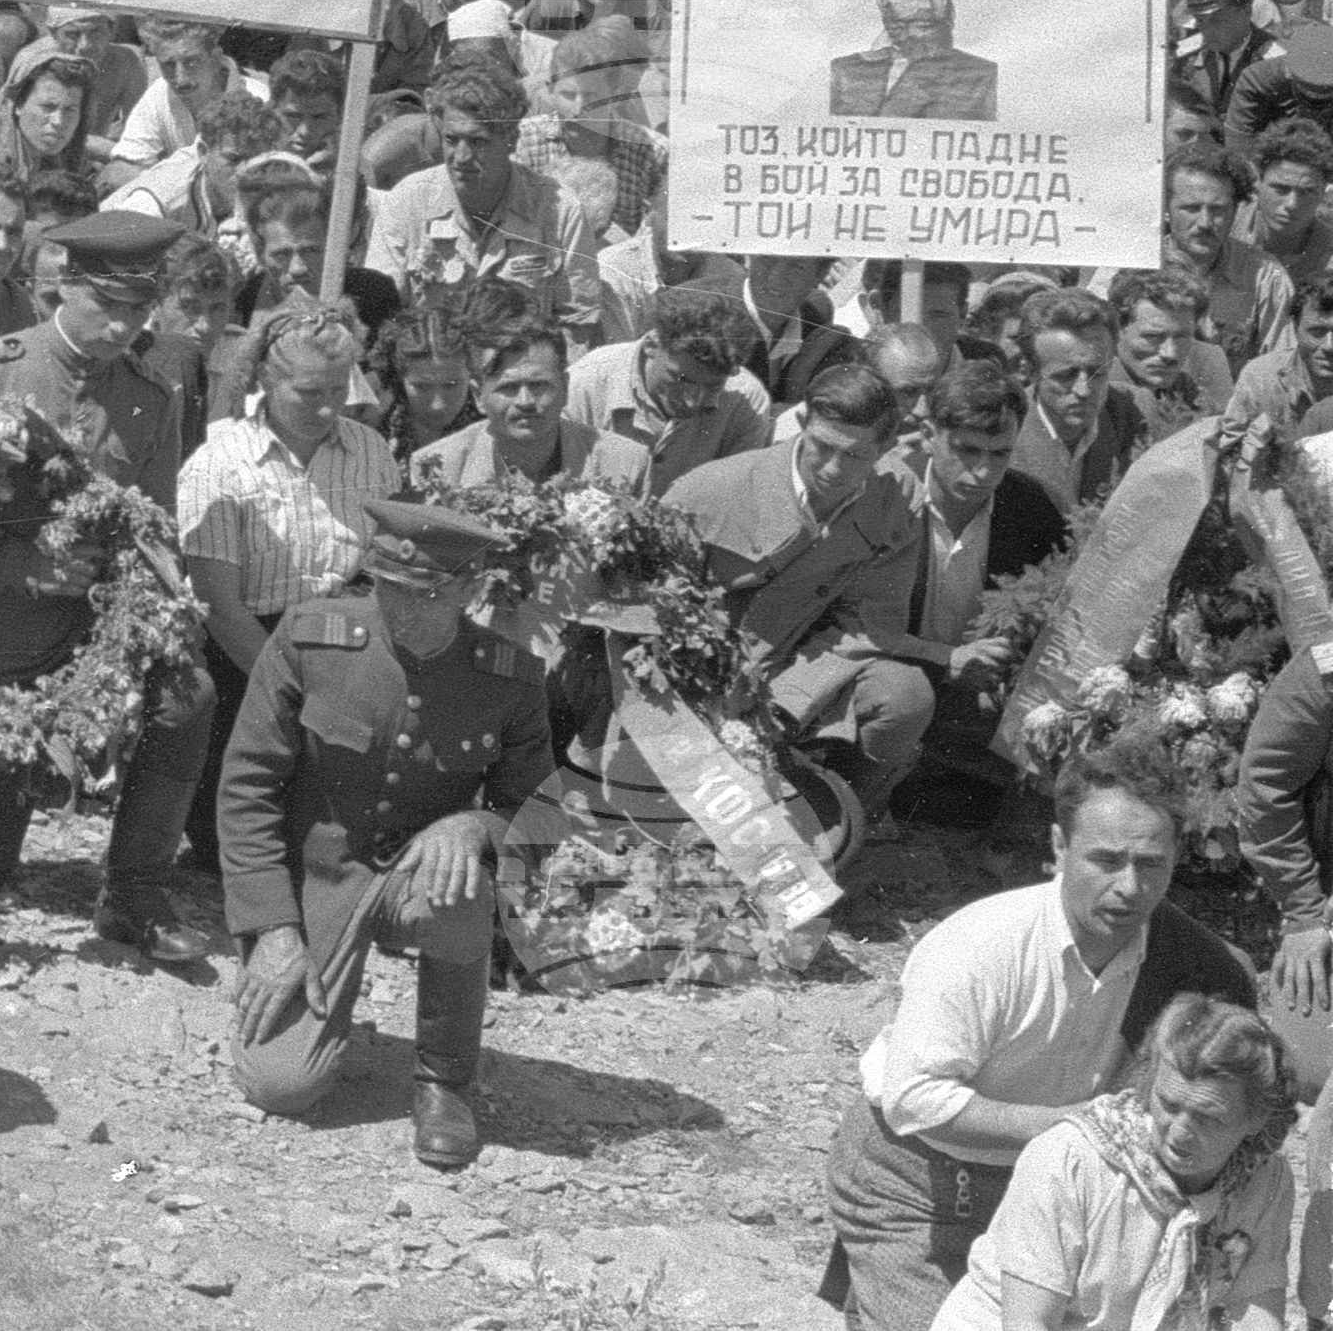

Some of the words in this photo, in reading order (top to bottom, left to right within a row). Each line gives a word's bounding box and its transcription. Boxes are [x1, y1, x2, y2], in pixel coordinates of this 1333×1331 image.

[797, 119, 909, 158] КОЙТО
[932, 131, 1068, 165] ПАДНЕ
[723, 163, 744, 194] В
[760, 161, 829, 195] БОЙ
[839, 165, 882, 197] ЗА
[834, 204, 887, 243] НЕ
